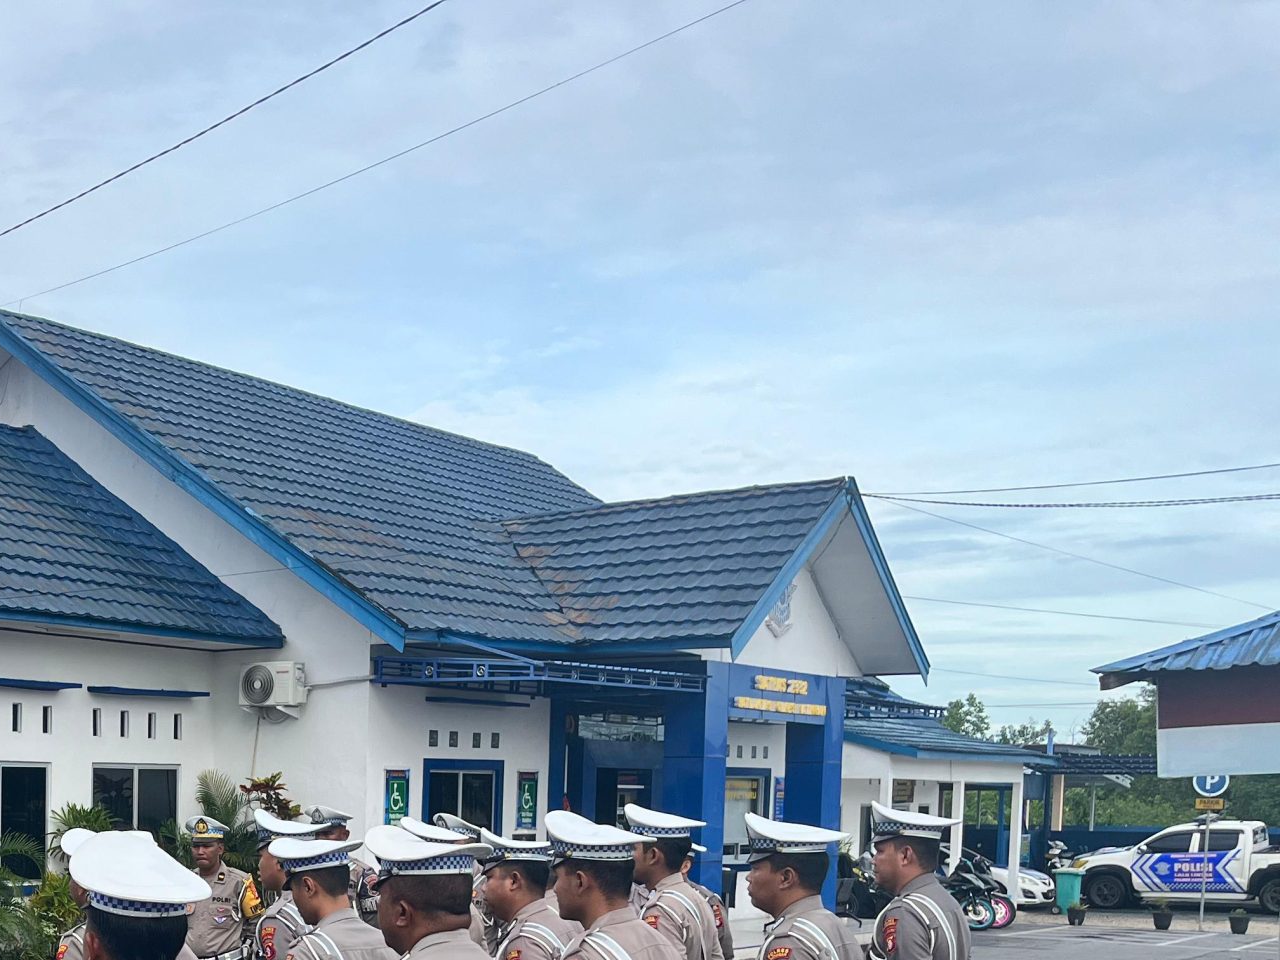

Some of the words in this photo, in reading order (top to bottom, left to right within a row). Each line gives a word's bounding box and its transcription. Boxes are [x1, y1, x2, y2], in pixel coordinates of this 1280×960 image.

[1205, 775, 1219, 790] P
[1173, 862, 1213, 872] POLISI
[212, 896, 231, 904] POLRI
